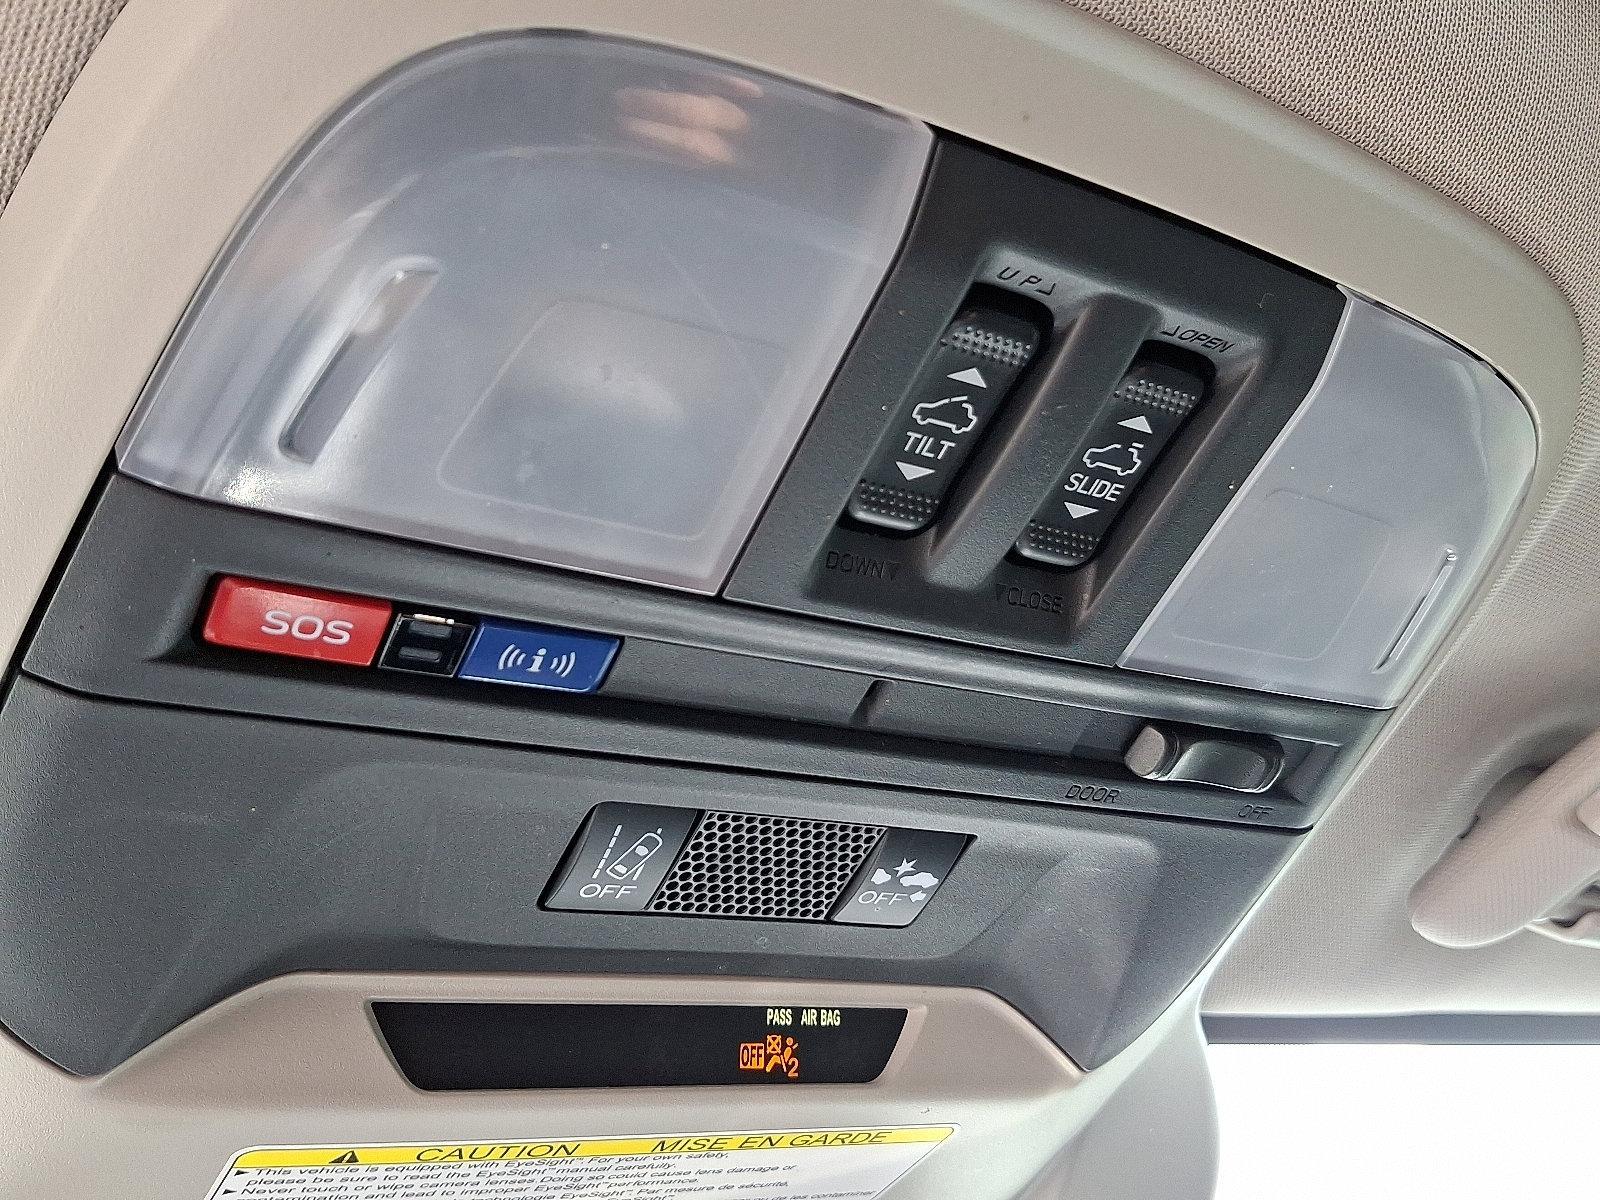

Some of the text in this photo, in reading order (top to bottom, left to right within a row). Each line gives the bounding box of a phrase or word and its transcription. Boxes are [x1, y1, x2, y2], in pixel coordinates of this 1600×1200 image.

[997, 266, 1039, 287] UP
[1177, 326, 1235, 353] OPEN
[903, 431, 955, 461] TILT
[1064, 472, 1125, 502] SLIDE
[825, 550, 886, 580] DOWN
[1007, 586, 1065, 614] CLOSE
[261, 609, 354, 646] SOS
[1065, 784, 1121, 804] DOOR
[1238, 804, 1274, 820] OFF
[579, 884, 638, 899] OFF
[857, 890, 913, 905] OFF
[766, 1008, 841, 1027] PASS AIR BAG
[741, 1045, 765, 1067] OFF
[416, 1131, 892, 1161] CAUTION MISE EN GARDE
[246, 1178, 307, 1187] please
[340, 1174, 378, 1182] sure
[403, 1172, 442, 1180] read
[446, 1171, 471, 1179] the
[556, 1165, 613, 1174] manual
[256, 1168, 292, 1176] This
[299, 1166, 360, 1175] vehicle
[384, 1163, 464, 1172] equipped
[468, 1161, 500, 1169] with
[587, 1156, 614, 1164] For
[615, 1155, 651, 1164] your
[241, 1187, 296, 1195] Never
[301, 1185, 348, 1193] touch
[377, 1182, 415, 1191] wipe
[420, 1179, 480, 1189] camera
[540, 1175, 584, 1183] Doing
[608, 1171, 649, 1180] could
[650, 1170, 692, 1178] cause
[726, 1165, 779, 1174] damage
[637, 1187, 663, 1195] Par
[664, 1184, 715, 1193] mesure
[718, 1183, 735, 1191] de
[365, 1191, 397, 1199] and
[401, 1190, 437, 1198] lead
[460, 1186, 531, 1196] improper
